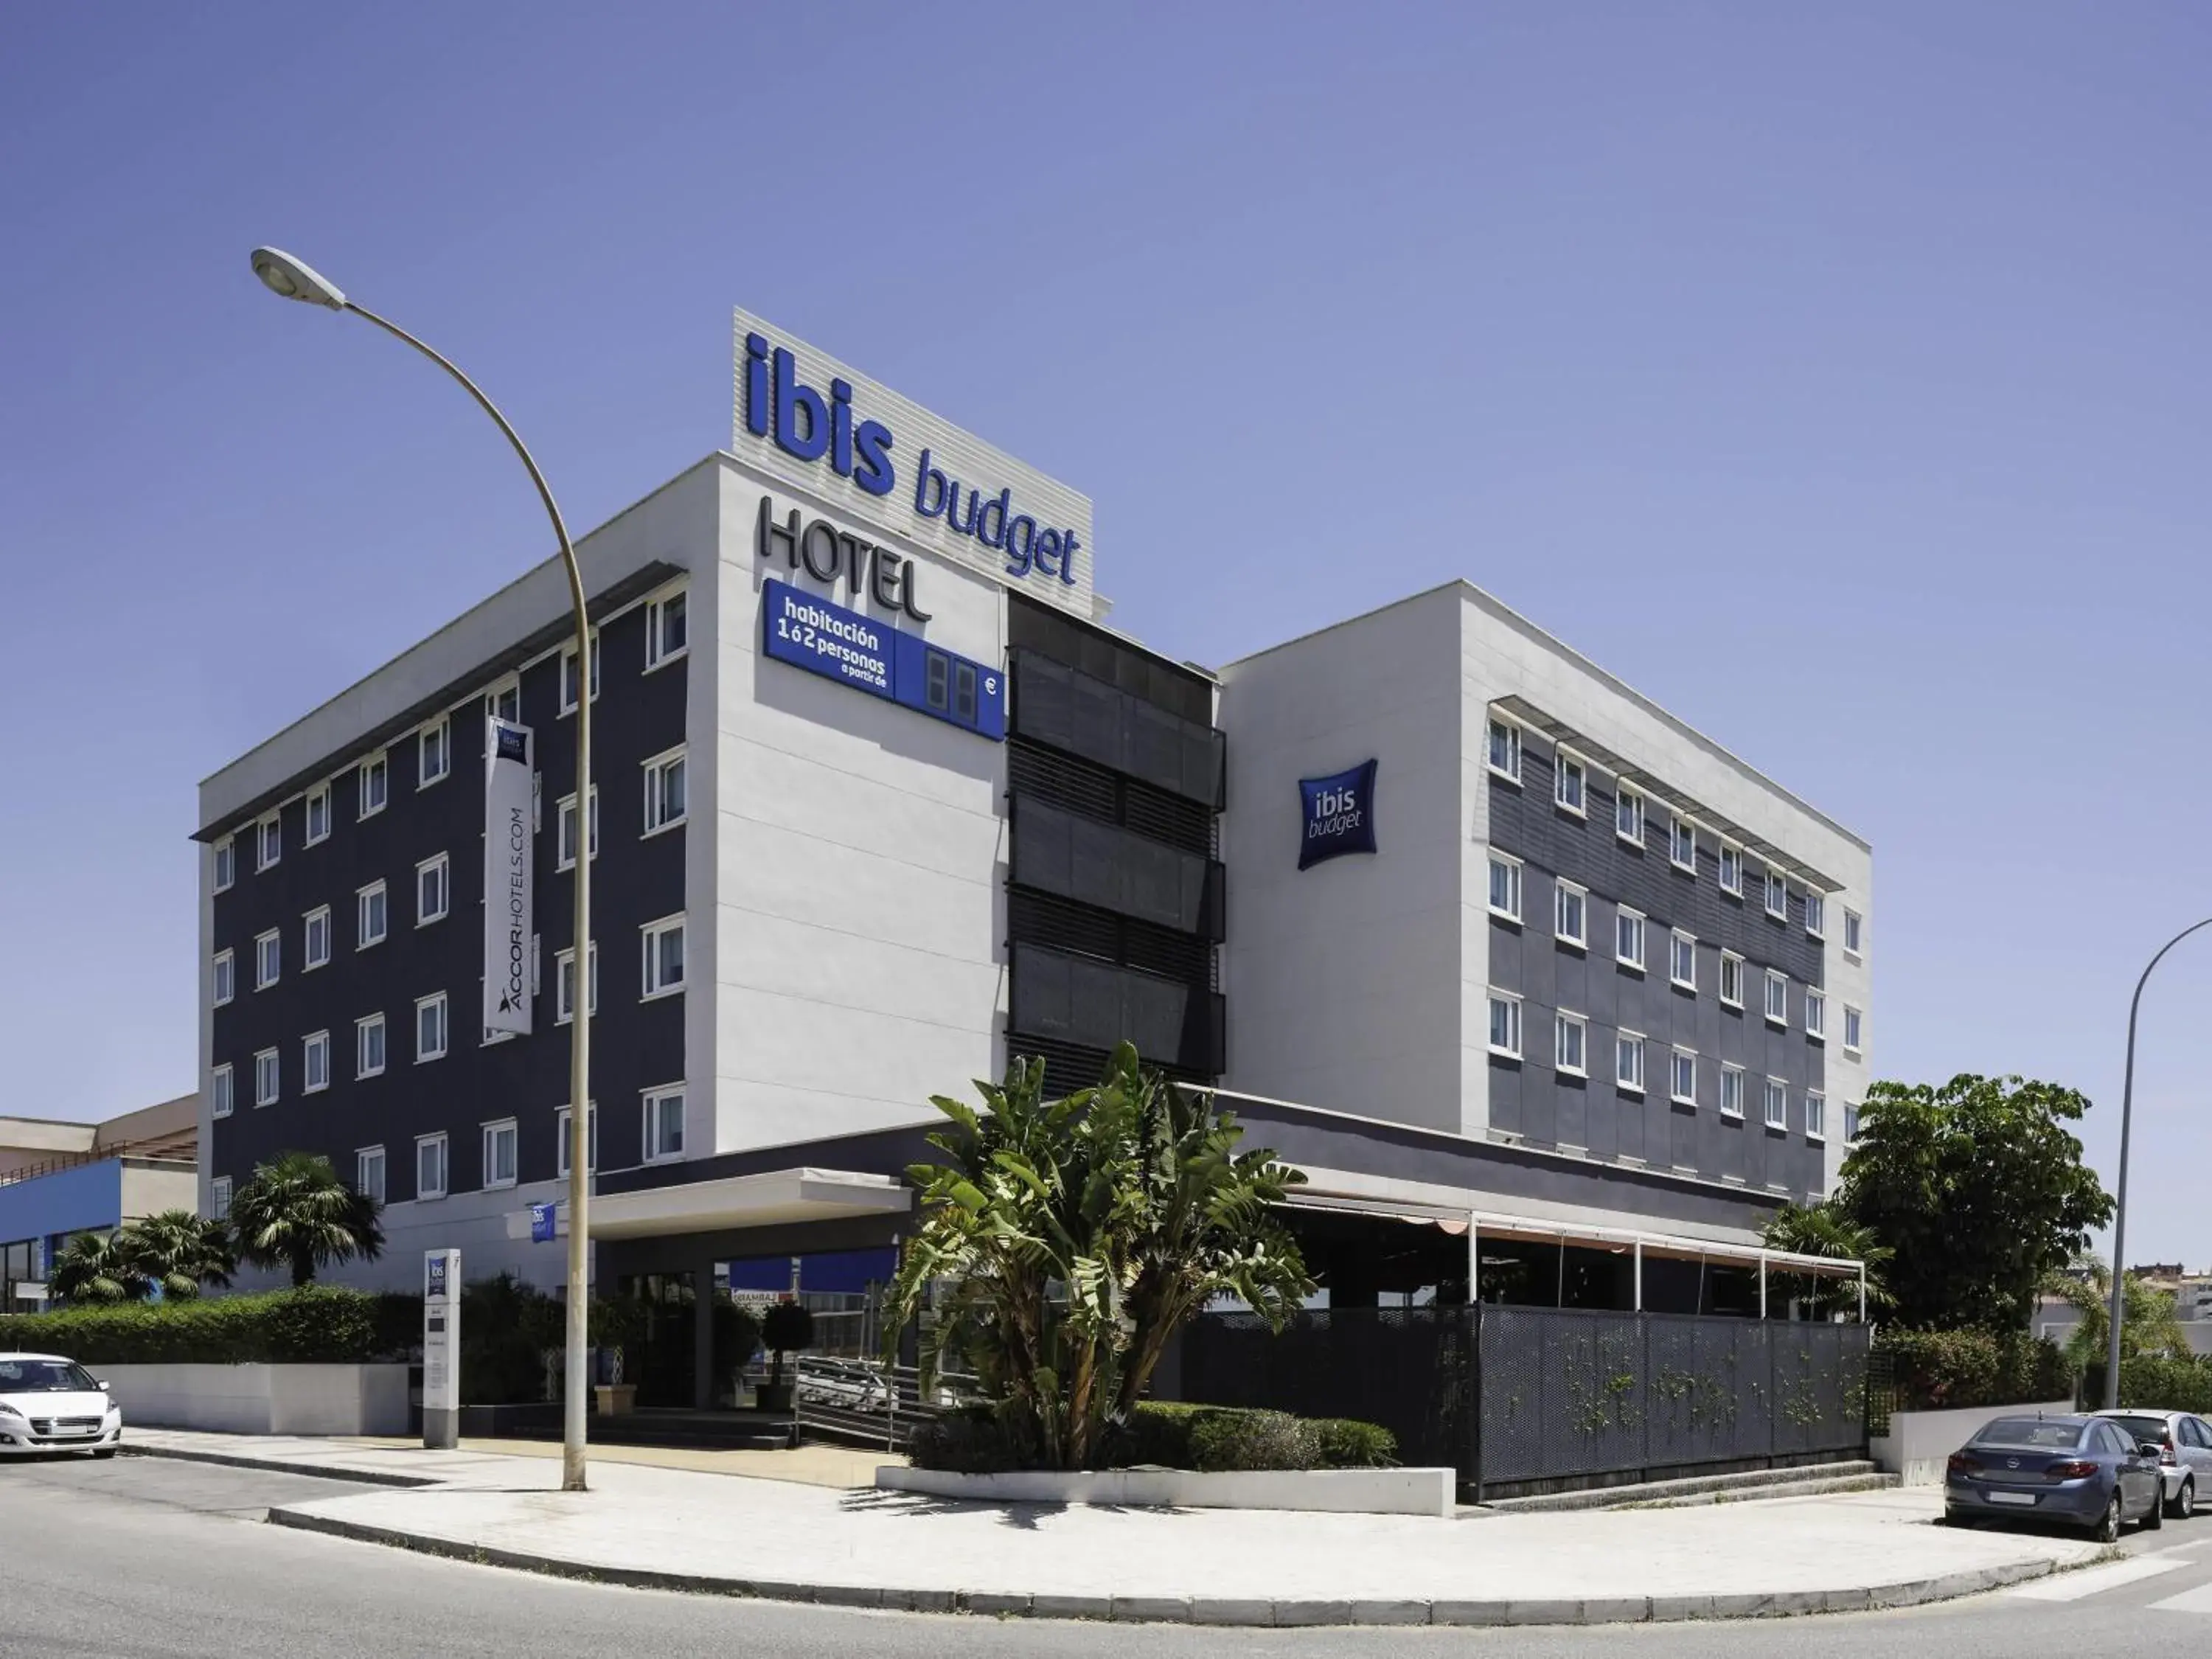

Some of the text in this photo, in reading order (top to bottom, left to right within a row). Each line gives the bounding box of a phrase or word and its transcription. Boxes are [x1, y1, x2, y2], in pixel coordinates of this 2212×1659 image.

[745, 332, 1082, 585] ibis budget
[760, 495, 932, 622] HOTEL
[778, 617, 790, 639] 1
[804, 627, 815, 649] 2
[817, 637, 886, 675] personas
[785, 596, 879, 652] habitación
[841, 664, 848, 674] a
[849, 666, 874, 684] partir
[1308, 810, 1363, 839] budget
[1315, 786, 1355, 819] ibis
[509, 807, 524, 1011] ACCORHOTELS.COM
